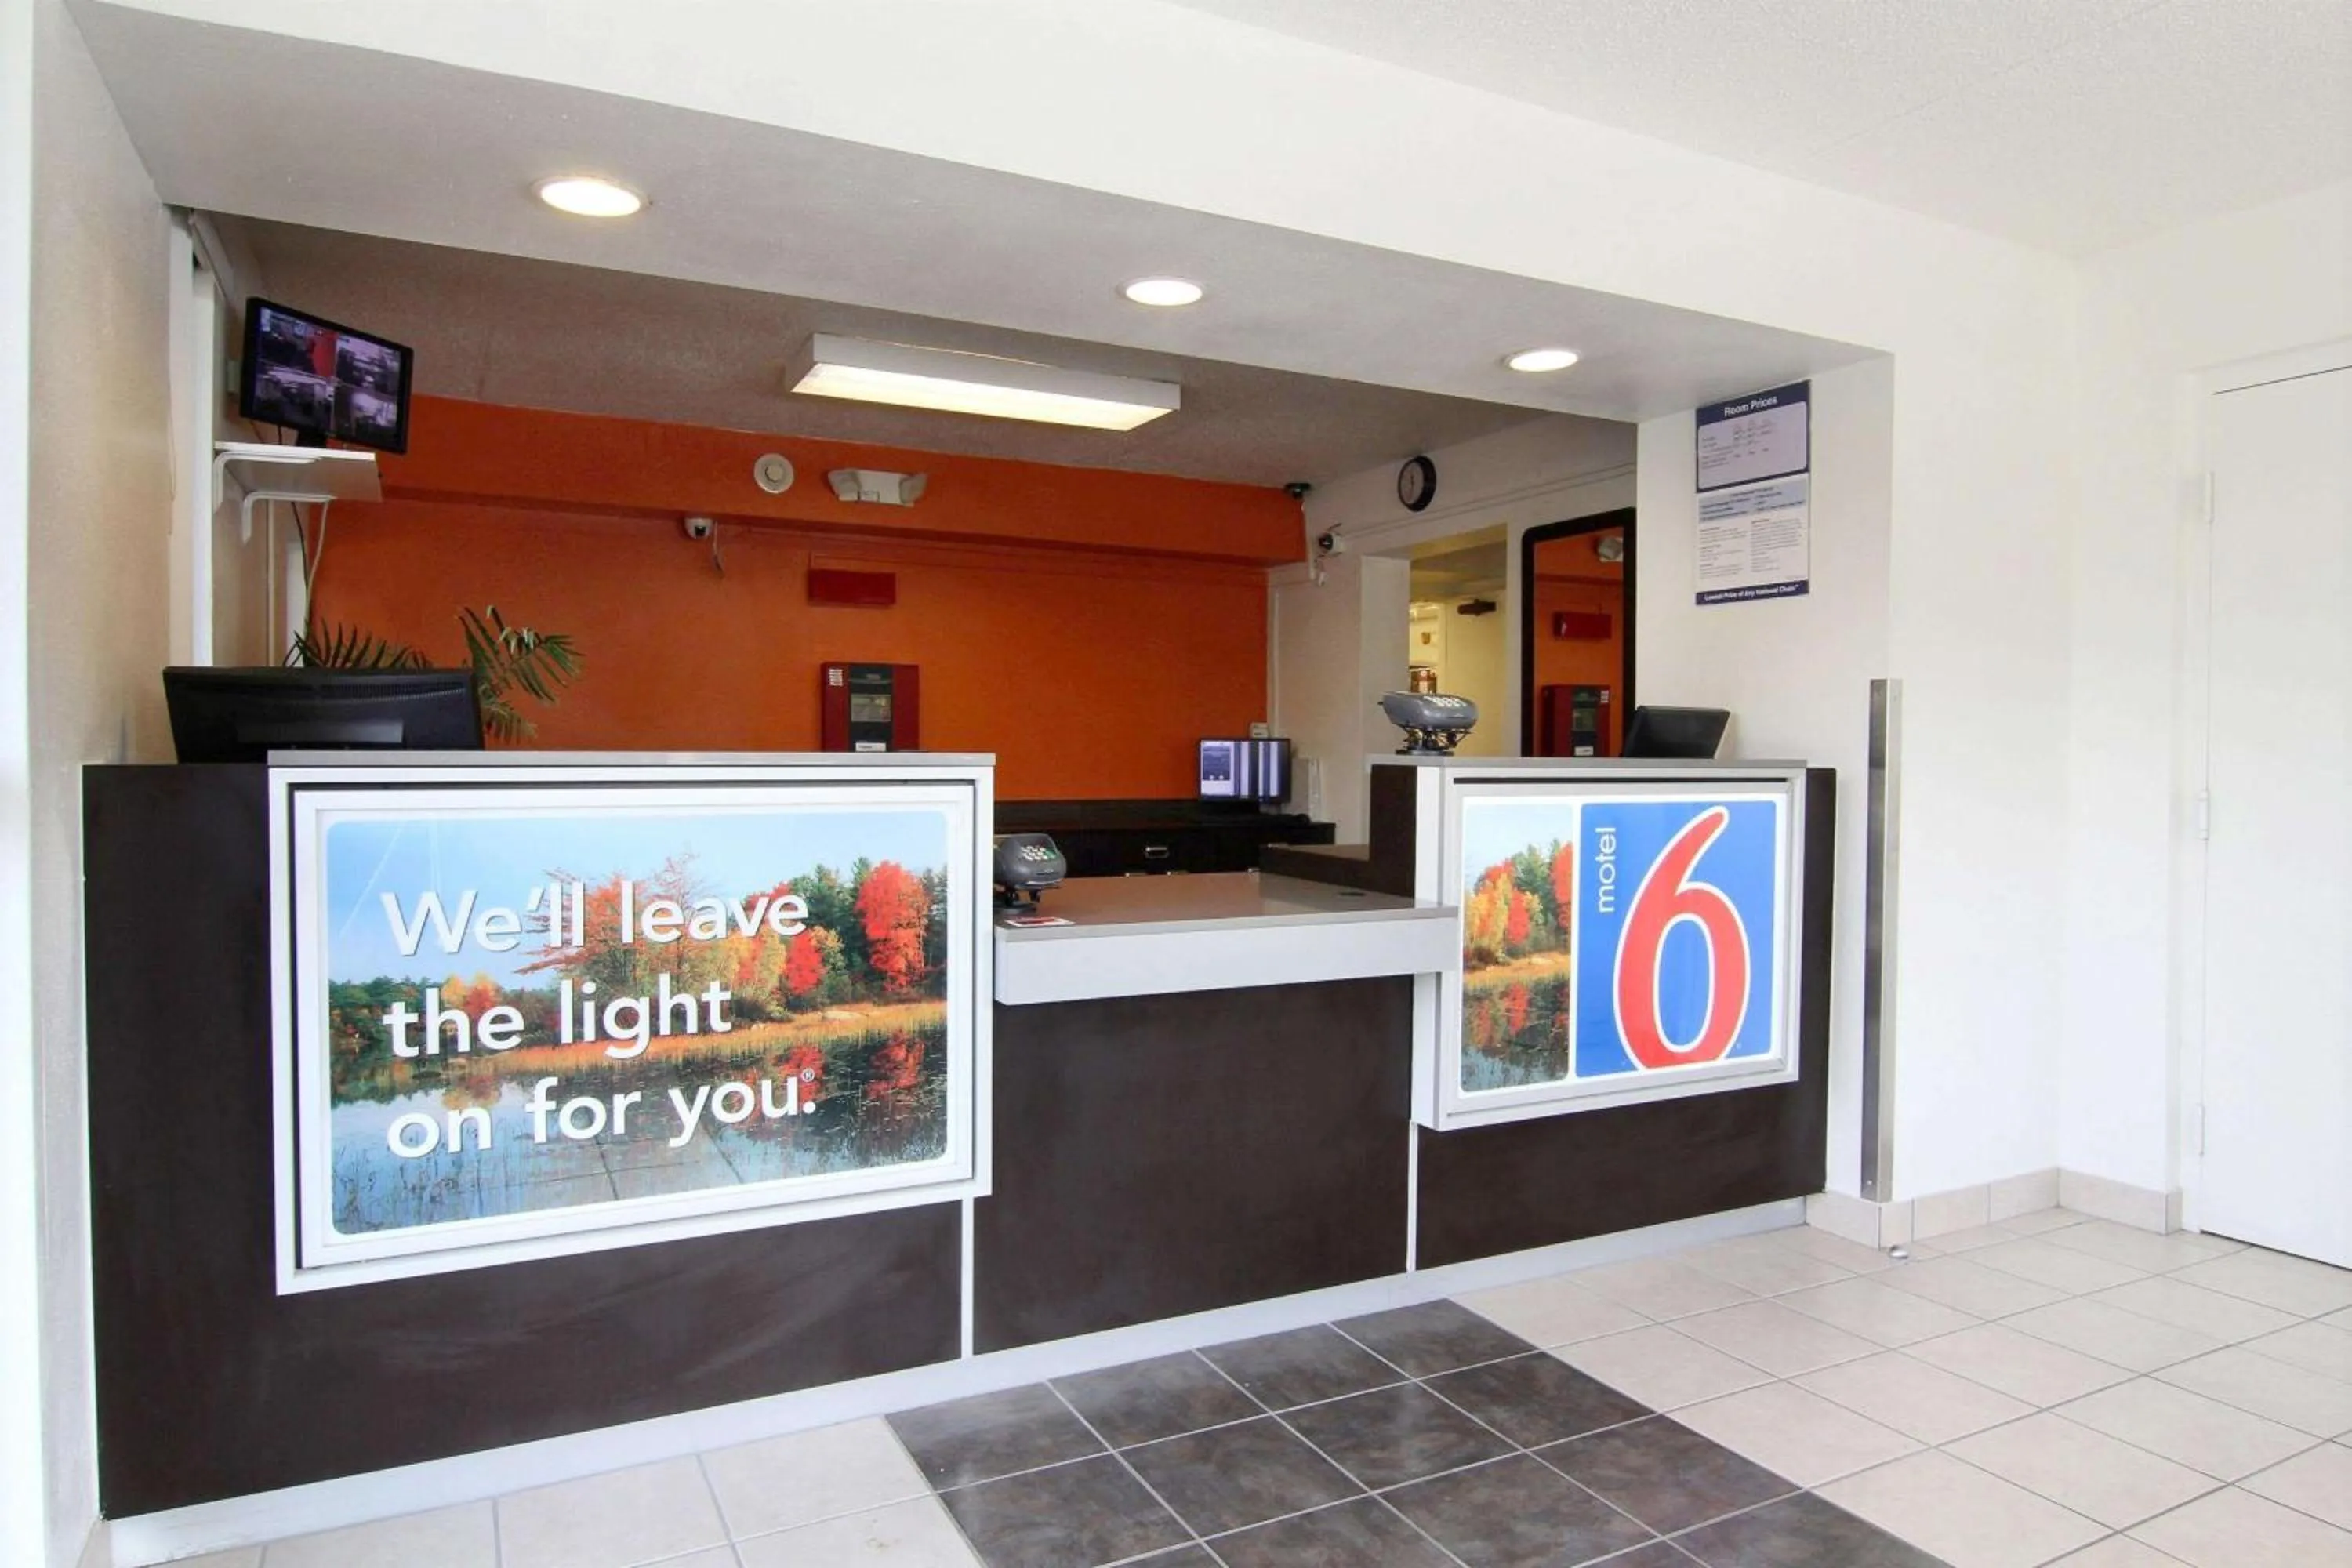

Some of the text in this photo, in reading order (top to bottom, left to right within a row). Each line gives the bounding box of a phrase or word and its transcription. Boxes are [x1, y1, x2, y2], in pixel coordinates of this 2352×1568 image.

[1724, 396, 1778, 417] Room Prices
[380, 880, 808, 957] We'll leave
[1595, 805, 1751, 1071] motel 6
[383, 972, 732, 1060] the light
[387, 1106, 492, 1159] on
[525, 1076, 642, 1145] for
